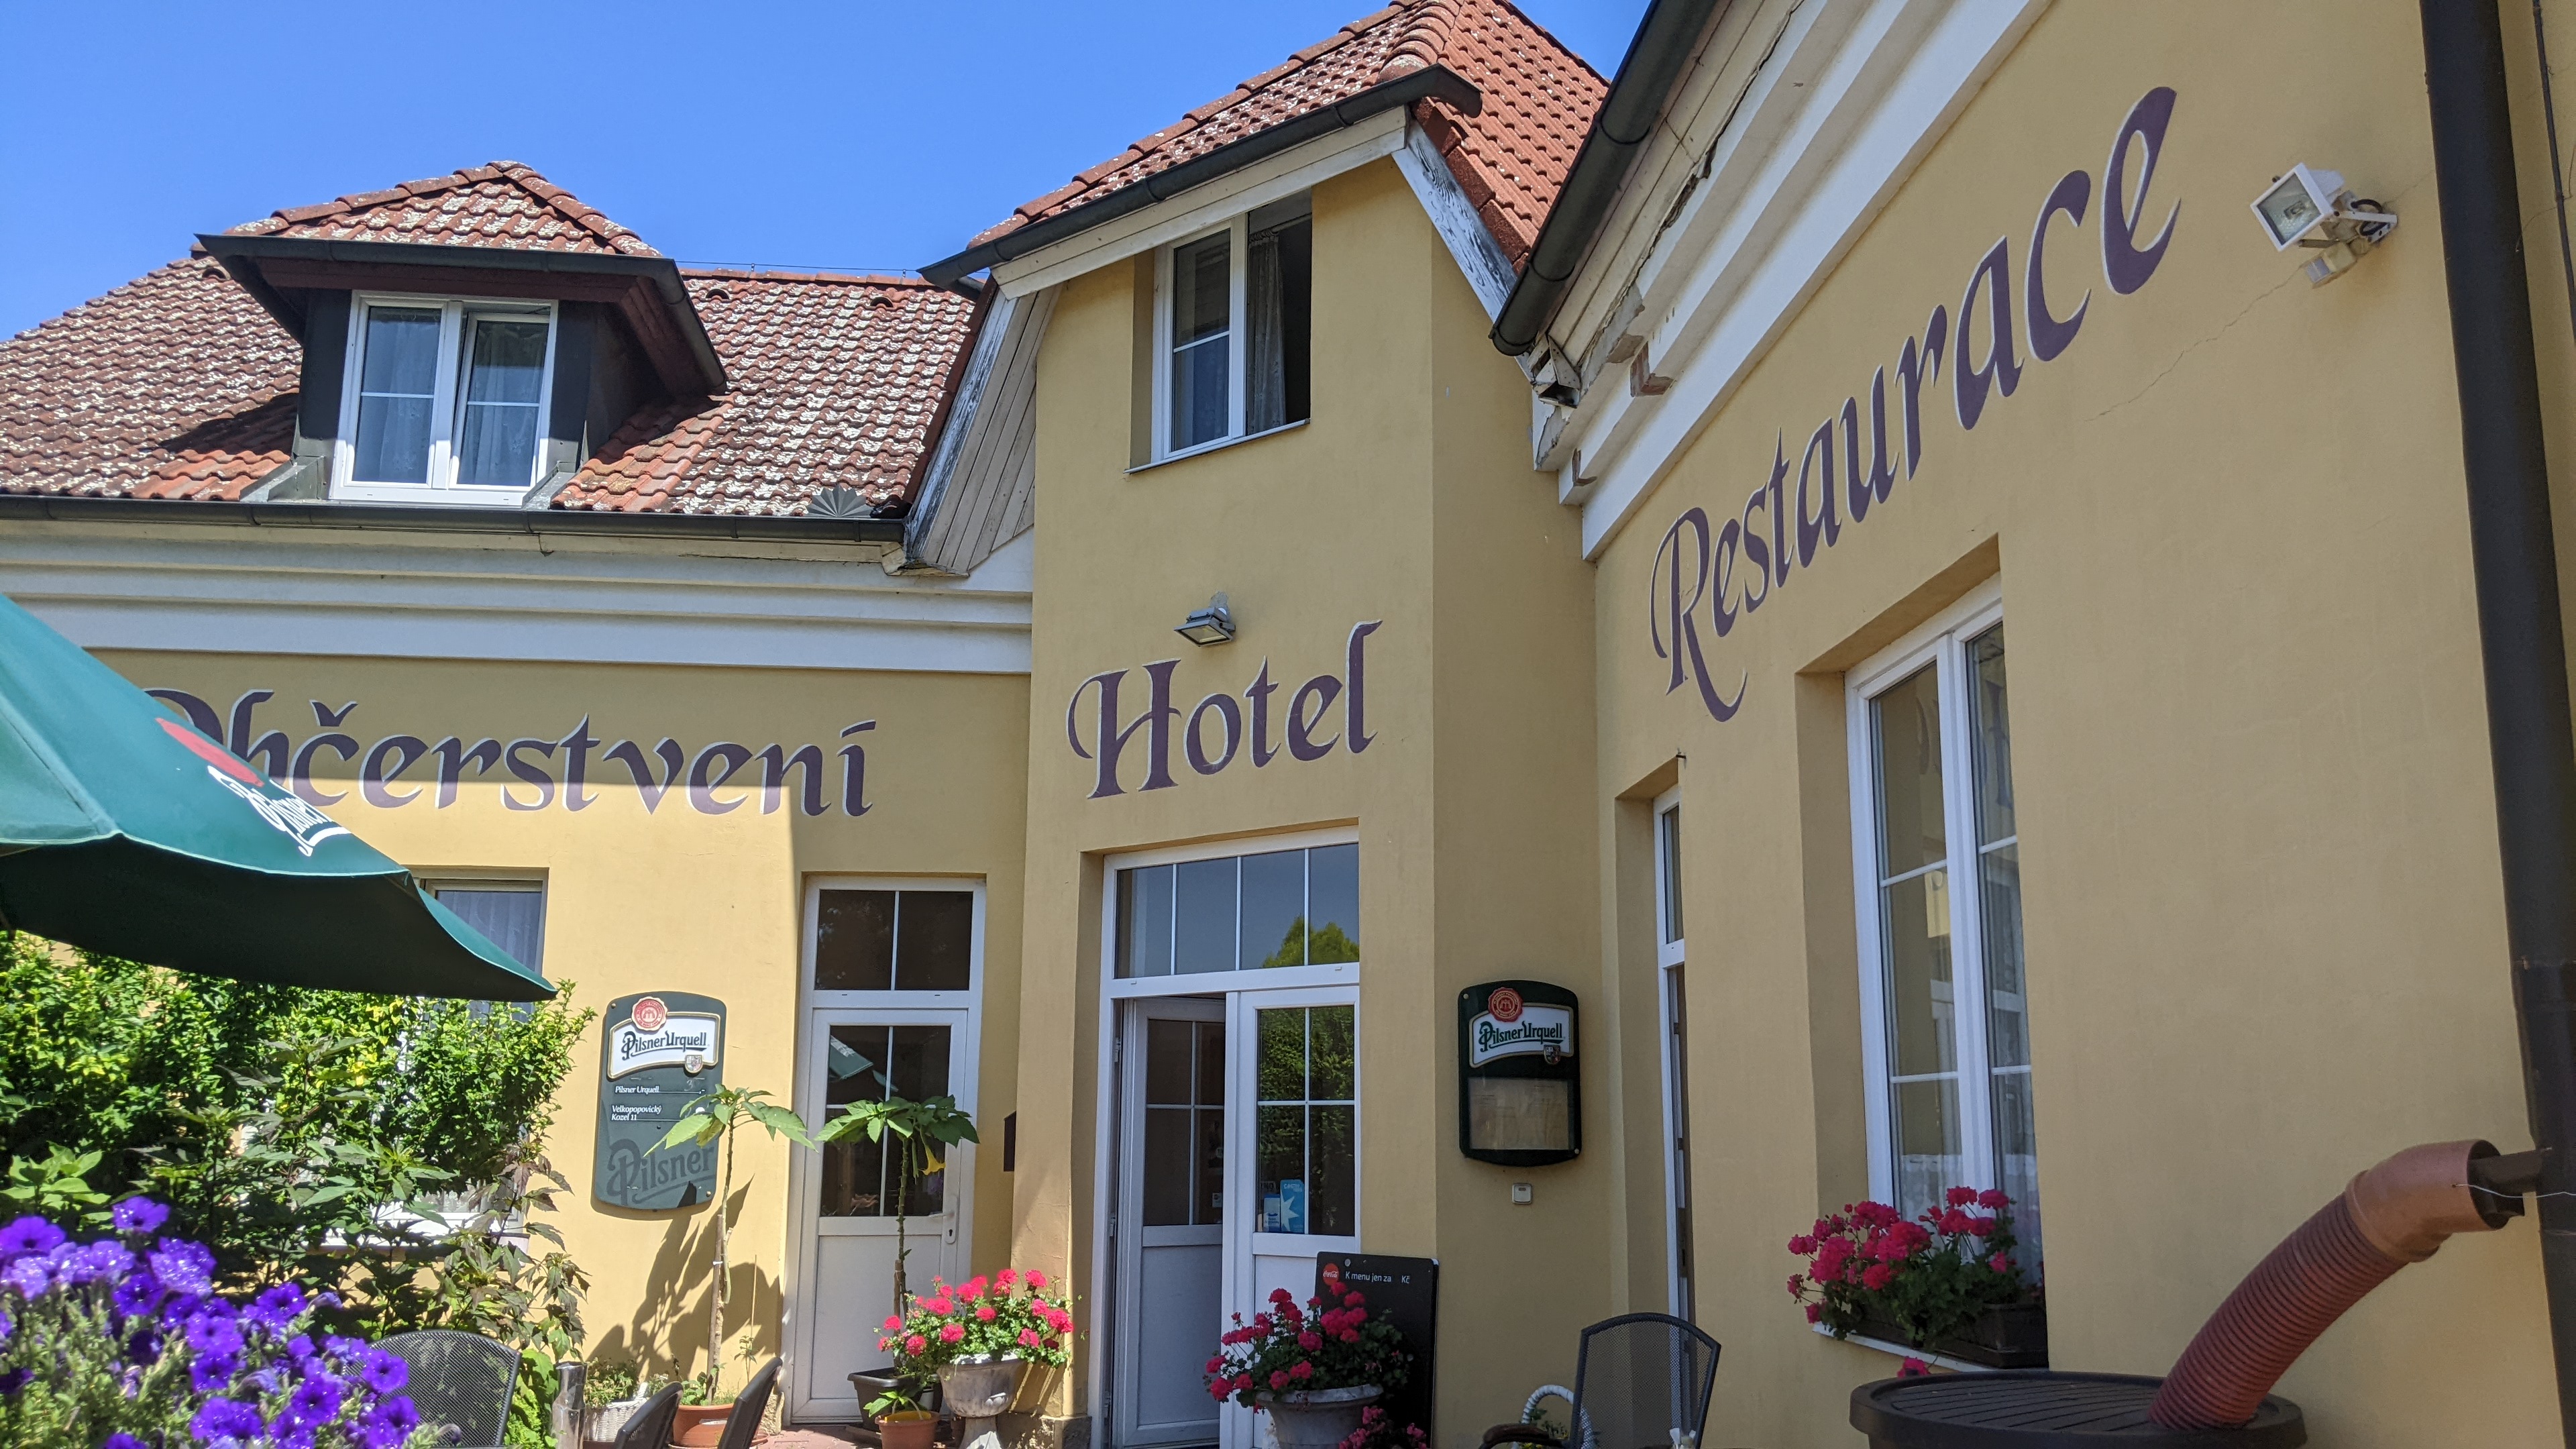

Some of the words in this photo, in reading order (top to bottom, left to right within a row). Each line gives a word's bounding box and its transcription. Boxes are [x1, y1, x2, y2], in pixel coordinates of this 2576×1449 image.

[1649, 86, 2182, 722] Restaurace
[1065, 619, 1383, 800] Hotel
[621, 1031, 666, 1061] Pilsner
[665, 1030, 707, 1053] Urquell
[1479, 1021, 1524, 1052] Pilsner
[1522, 1020, 1563, 1044] Urquell
[615, 1085, 636, 1093] Pilsner
[637, 1085, 659, 1095] Urquell
[611, 1113, 630, 1121] Kozel
[612, 1106, 662, 1115] Velkopopovický
[606, 1138, 714, 1205] Pilsner
[1345, 1271, 1350, 1279] K
[1371, 1273, 1382, 1283] jen
[1401, 1275, 1410, 1283] Kč
